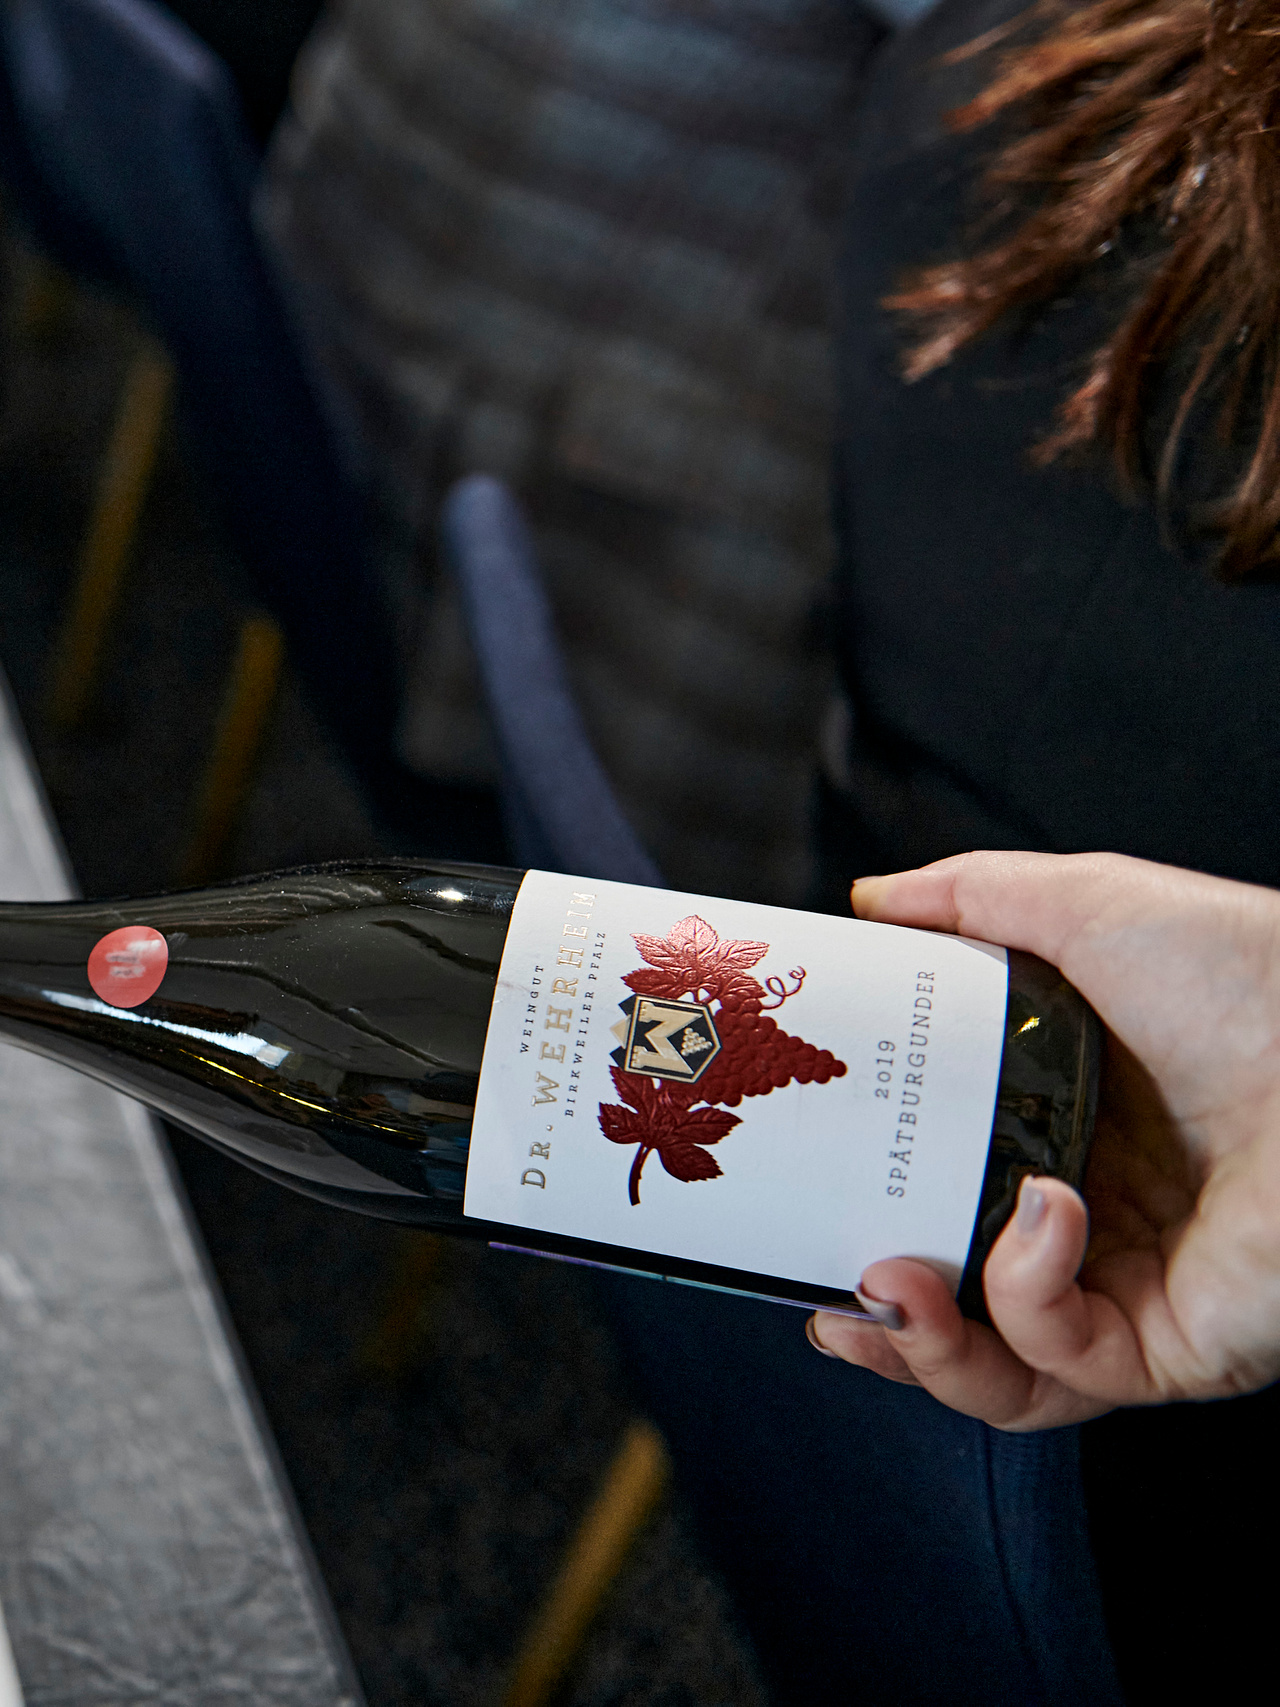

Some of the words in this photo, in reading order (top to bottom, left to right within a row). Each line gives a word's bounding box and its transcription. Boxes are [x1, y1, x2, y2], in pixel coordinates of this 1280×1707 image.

[519, 963, 545, 1054] WEINGUT
[531, 890, 598, 1108] WEHRHEIM
[564, 990, 595, 1118] BIRKWEILER
[587, 931, 606, 981] PFALZ
[874, 1039, 896, 1100] 2019
[886, 970, 936, 1199] SPÄTBURGUNDER
[520, 1123, 554, 1190] DR.
